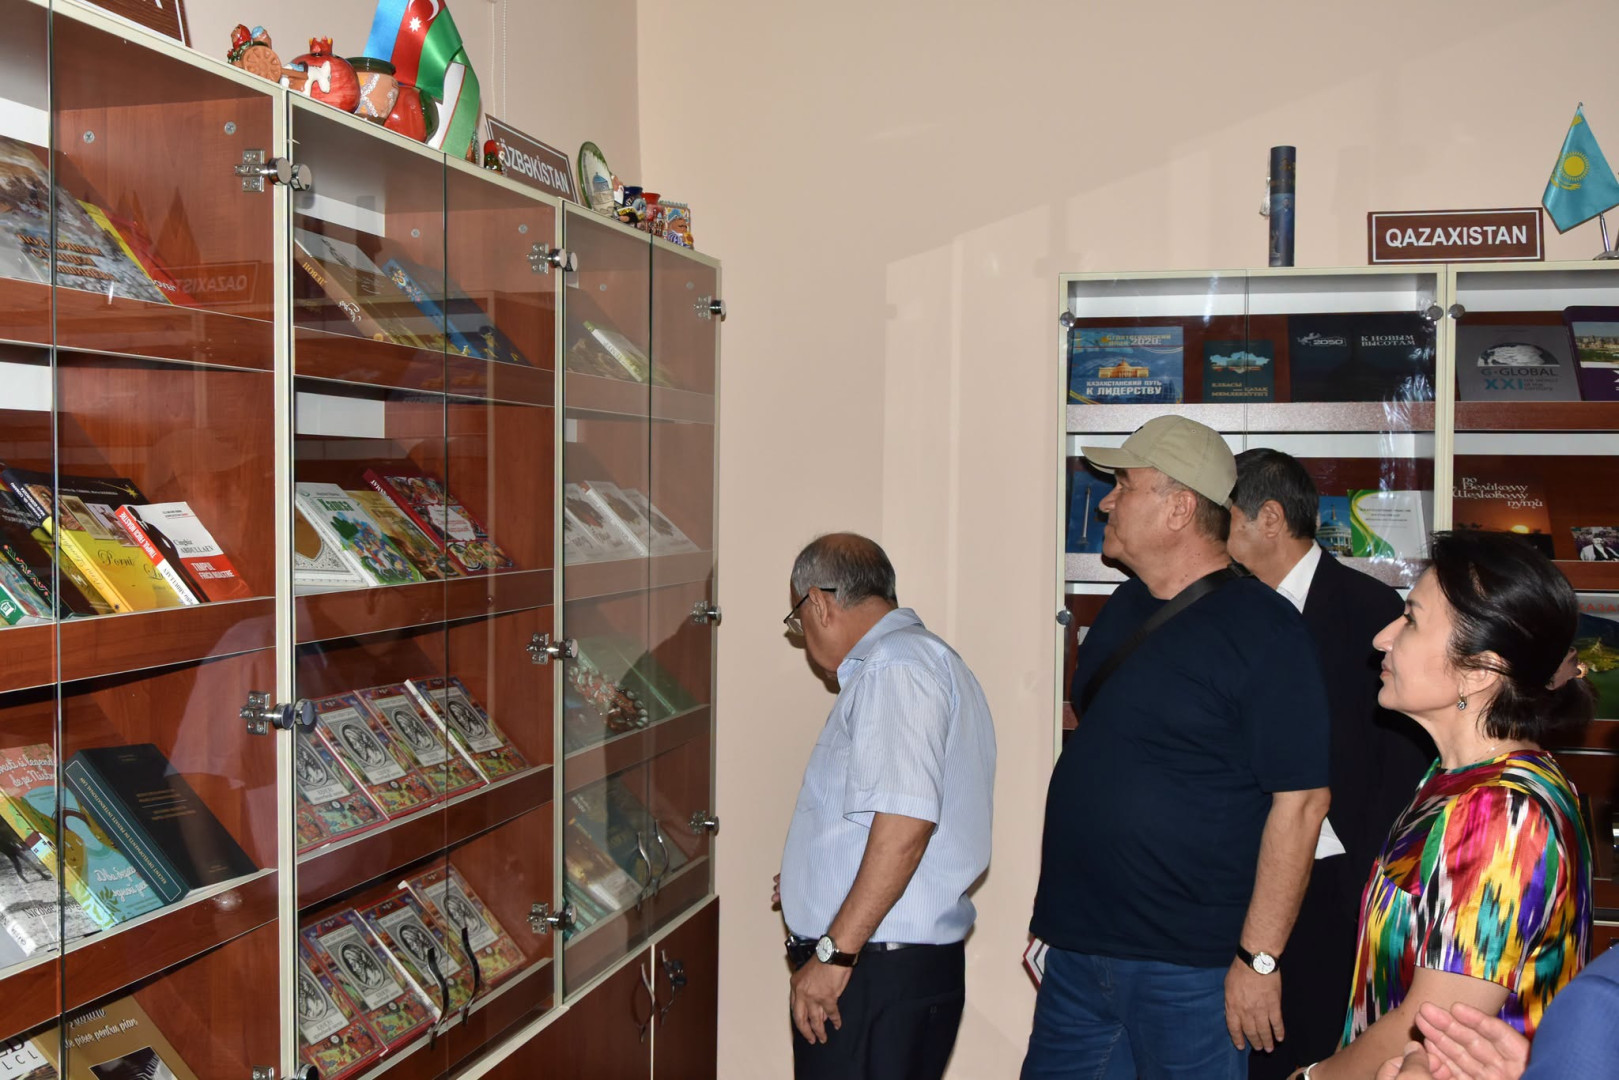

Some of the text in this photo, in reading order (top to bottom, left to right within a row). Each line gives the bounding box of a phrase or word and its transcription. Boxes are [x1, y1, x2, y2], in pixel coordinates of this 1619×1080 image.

[500, 138, 570, 194] ÖZBƏKİSTAN
[1386, 226, 1527, 248] QAZAXISTAN
[1086, 387, 1162, 396] К ЛИДЕРСТВУ
[1485, 378, 1524, 390] XXI
[24, 904, 57, 919] Nicolae
[94, 1025, 120, 1041] pentru
[118, 1018, 139, 1033] pian
